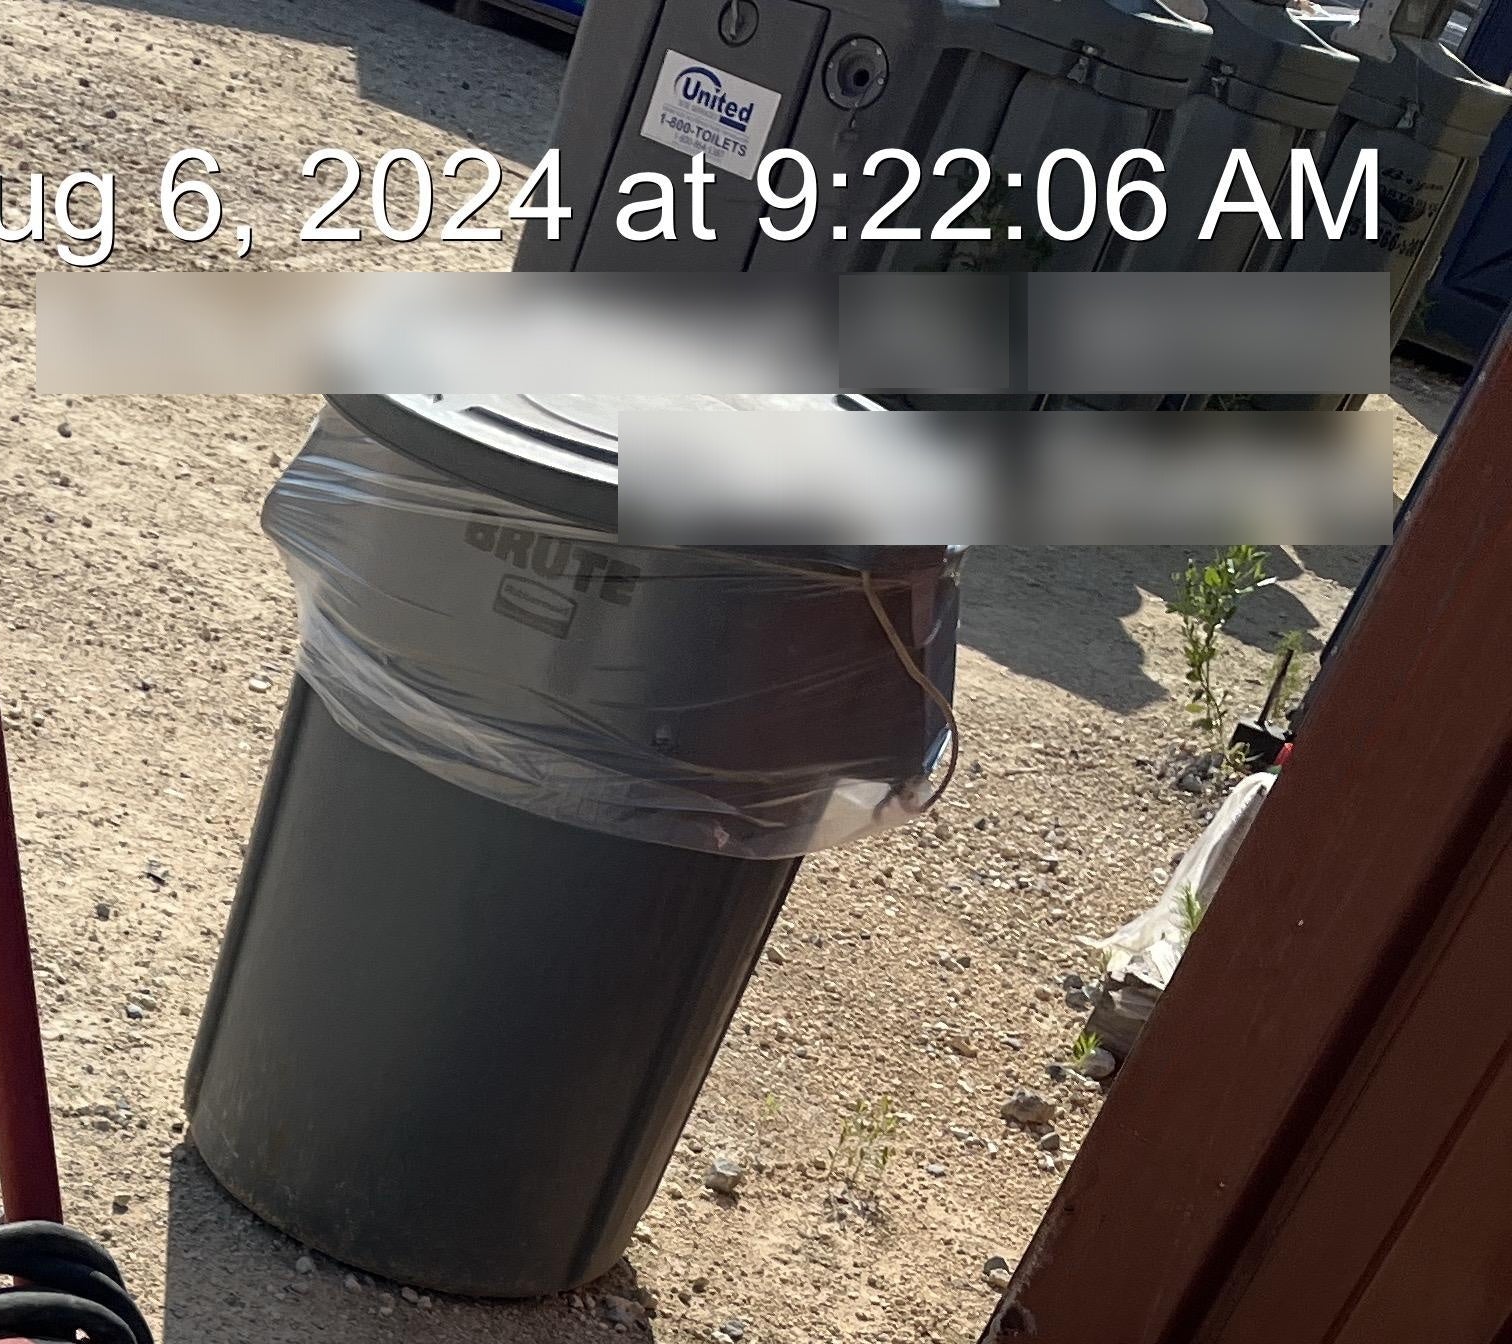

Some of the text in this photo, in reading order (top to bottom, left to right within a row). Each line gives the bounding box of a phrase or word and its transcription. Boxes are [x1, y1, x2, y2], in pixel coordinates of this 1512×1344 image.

[682, 77, 754, 123] United
[660, 113, 748, 157] 1-800-TOILETS
[464, 521, 641, 607] BRUTE
